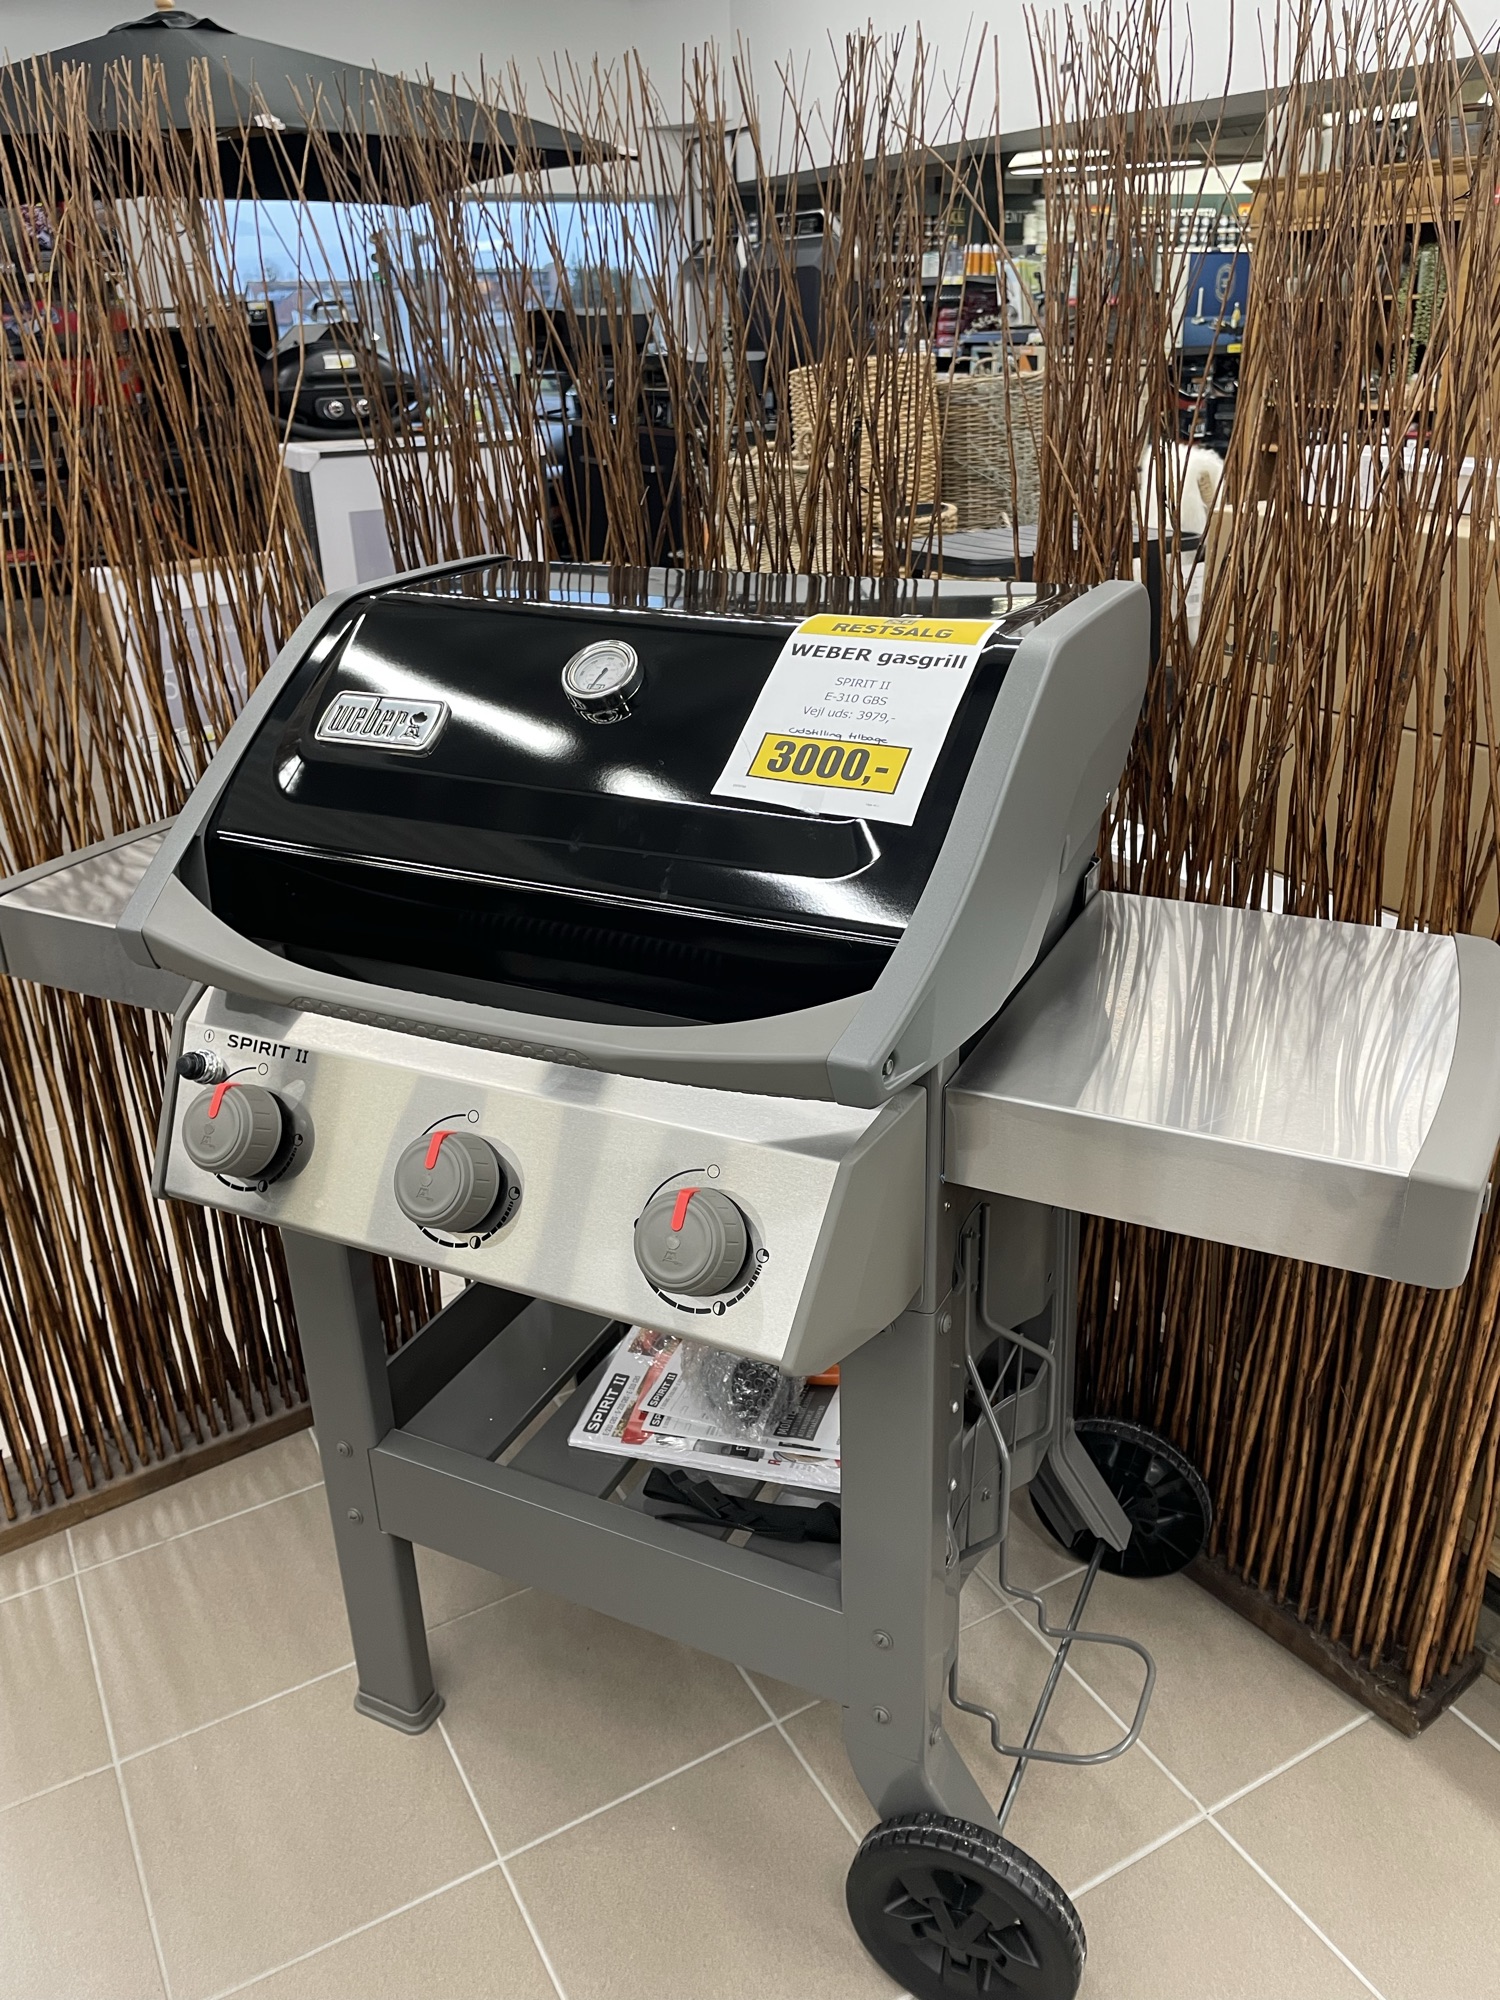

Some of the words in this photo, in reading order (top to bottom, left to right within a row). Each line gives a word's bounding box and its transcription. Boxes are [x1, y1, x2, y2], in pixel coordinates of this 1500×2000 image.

[831, 622, 954, 639] RESTSALG
[790, 643, 872, 661] WEBER
[877, 651, 968, 669] gasgrill
[835, 677, 878, 689] SPIRIT
[879, 681, 892, 690] II
[824, 691, 860, 703] E-310
[862, 695, 888, 706] GBS
[803, 706, 825, 718] Vejl
[827, 709, 853, 719] uds:
[856, 710, 896, 724] 3979,-
[766, 740, 889, 786] 3000,-
[227, 1034, 291, 1059] SPIRIT
[295, 1048, 309, 1064] II
[587, 1388, 619, 1431] SPIRIT
[612, 1375, 627, 1386] II
[650, 1382, 671, 1407] SPIRIT
[666, 1373, 676, 1381] II
